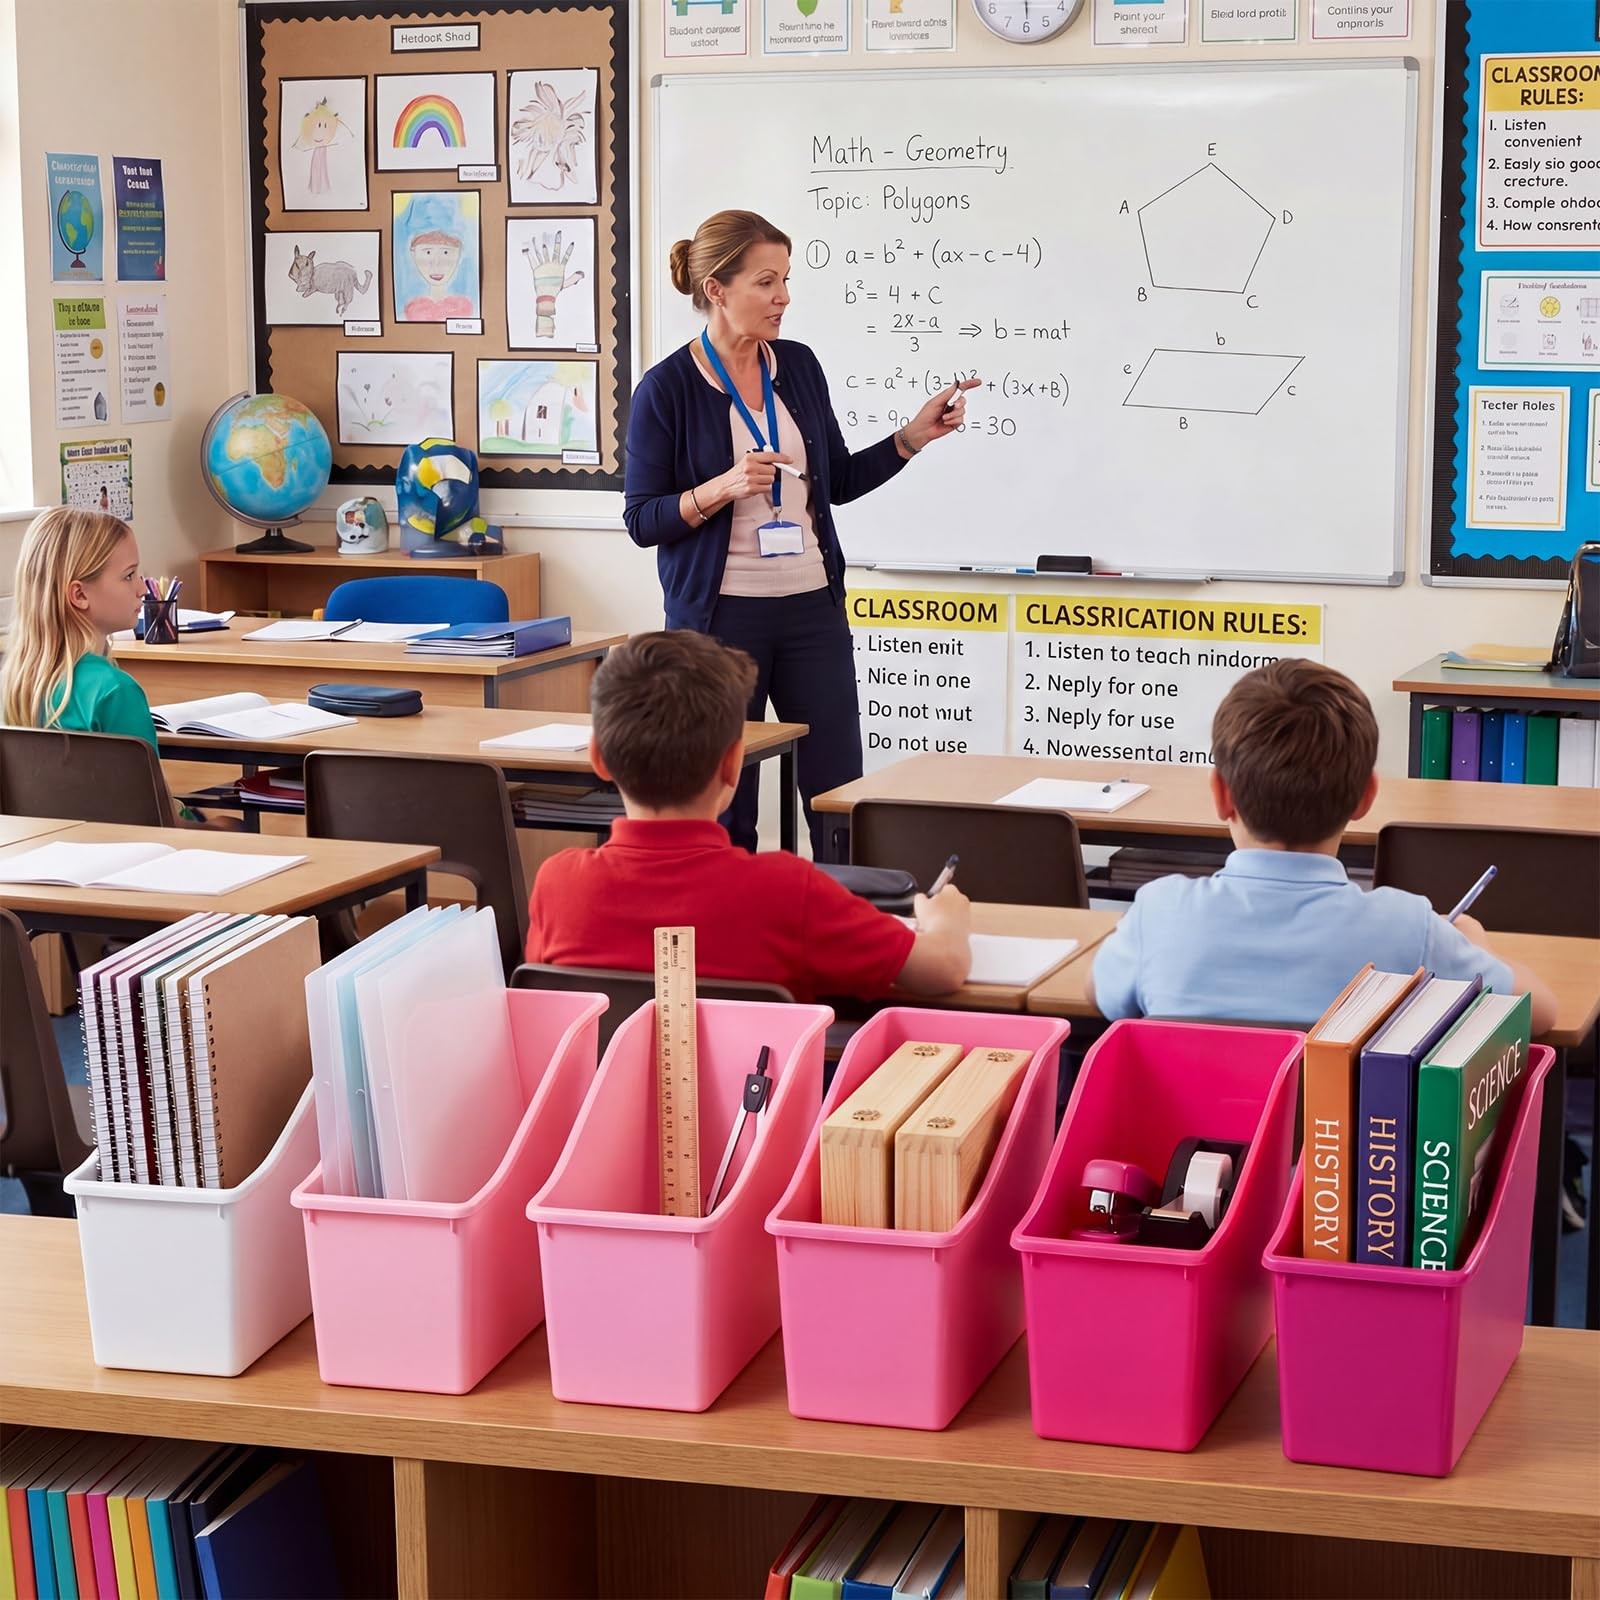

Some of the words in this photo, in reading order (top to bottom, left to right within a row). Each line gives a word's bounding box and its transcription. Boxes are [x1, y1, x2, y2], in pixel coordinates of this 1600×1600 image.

[1143, 12, 1166, 22] your
[1370, 6, 1393, 16] your
[1022, 21, 1031, 33] 6
[1041, 15, 1050, 28] 5
[1520, 88, 1584, 106] RULES:
[1504, 119, 1547, 131] Listen
[1207, 142, 1217, 157] E
[1504, 135, 1583, 148] convenient
[813, 136, 874, 165] Math
[905, 134, 1008, 174] Geometry
[1488, 158, 1500, 170] 2.
[1545, 157, 1566, 170] sio
[1503, 176, 1568, 187] crecture.
[807, 186, 870, 219] Topic:
[883, 184, 971, 223] Polygons
[1118, 199, 1130, 215] A
[1487, 197, 1499, 209] 3.
[1503, 196, 1556, 212] Comple
[1282, 209, 1294, 225] D
[1486, 219, 1498, 231] 4.
[1503, 219, 1533, 231] How
[888, 284, 900, 305] 4
[1137, 286, 1148, 303] B
[1246, 294, 1260, 309] C
[1033, 319, 1072, 340] mat
[1215, 331, 1226, 346] b
[986, 415, 1017, 437] 30
[1179, 416, 1189, 430] B
[853, 598, 998, 623] CLASSROOM
[1026, 604, 1215, 632] CLASSRICATION
[1223, 611, 1307, 636] RULES:
[868, 635, 922, 653] Listen
[1025, 641, 1040, 658] 1.
[1048, 642, 1104, 661] Listen
[1111, 645, 1130, 662] to
[1137, 647, 1191, 666] teach
[868, 667, 907, 685] Nice
[913, 669, 930, 687] in
[936, 675, 971, 688] one
[1025, 673, 1040, 691] 2.
[1047, 674, 1102, 698] Neply
[1108, 676, 1135, 695] for
[1141, 683, 1178, 697] one
[868, 700, 892, 717] Do
[898, 704, 929, 719] not
[1023, 706, 1040, 723] 3.
[1047, 707, 1101, 730] Neply
[1107, 708, 1134, 728] for
[1141, 716, 1175, 730] use
[868, 732, 892, 749] Do
[898, 736, 929, 752] not
[935, 740, 968, 754] use
[1023, 738, 1040, 755] 4.
[1047, 739, 1173, 763] Nowessental
[1468, 1038, 1522, 1130] SCIENCE
[1313, 1118, 1340, 1255] HISTORY
[1367, 1116, 1397, 1260] HISTORY
[1420, 1140, 1450, 1271] SCIENCE
